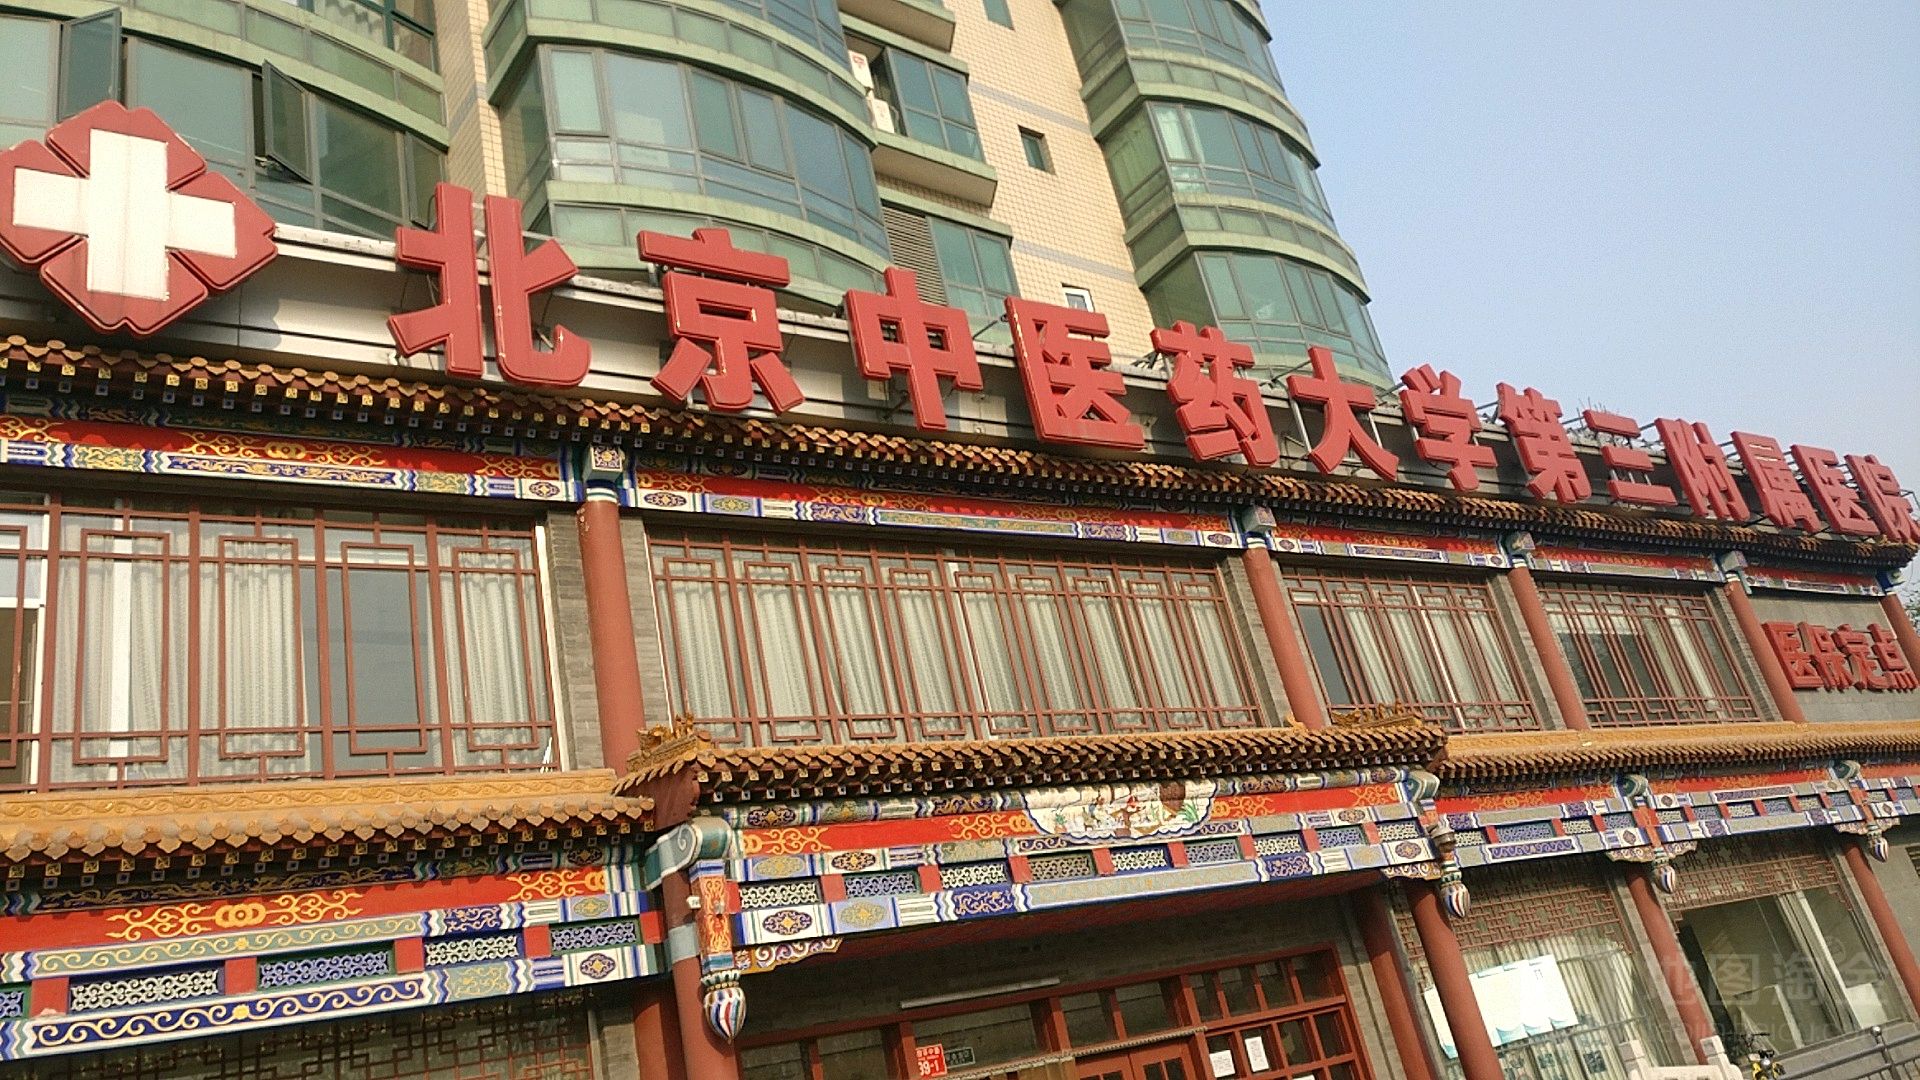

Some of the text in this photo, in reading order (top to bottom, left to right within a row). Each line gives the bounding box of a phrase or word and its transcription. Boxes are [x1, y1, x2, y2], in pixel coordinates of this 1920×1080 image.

[387, 182, 1920, 543] 北京中医药大学第三附属医院
[1762, 621, 1919, 692] 医保定点
